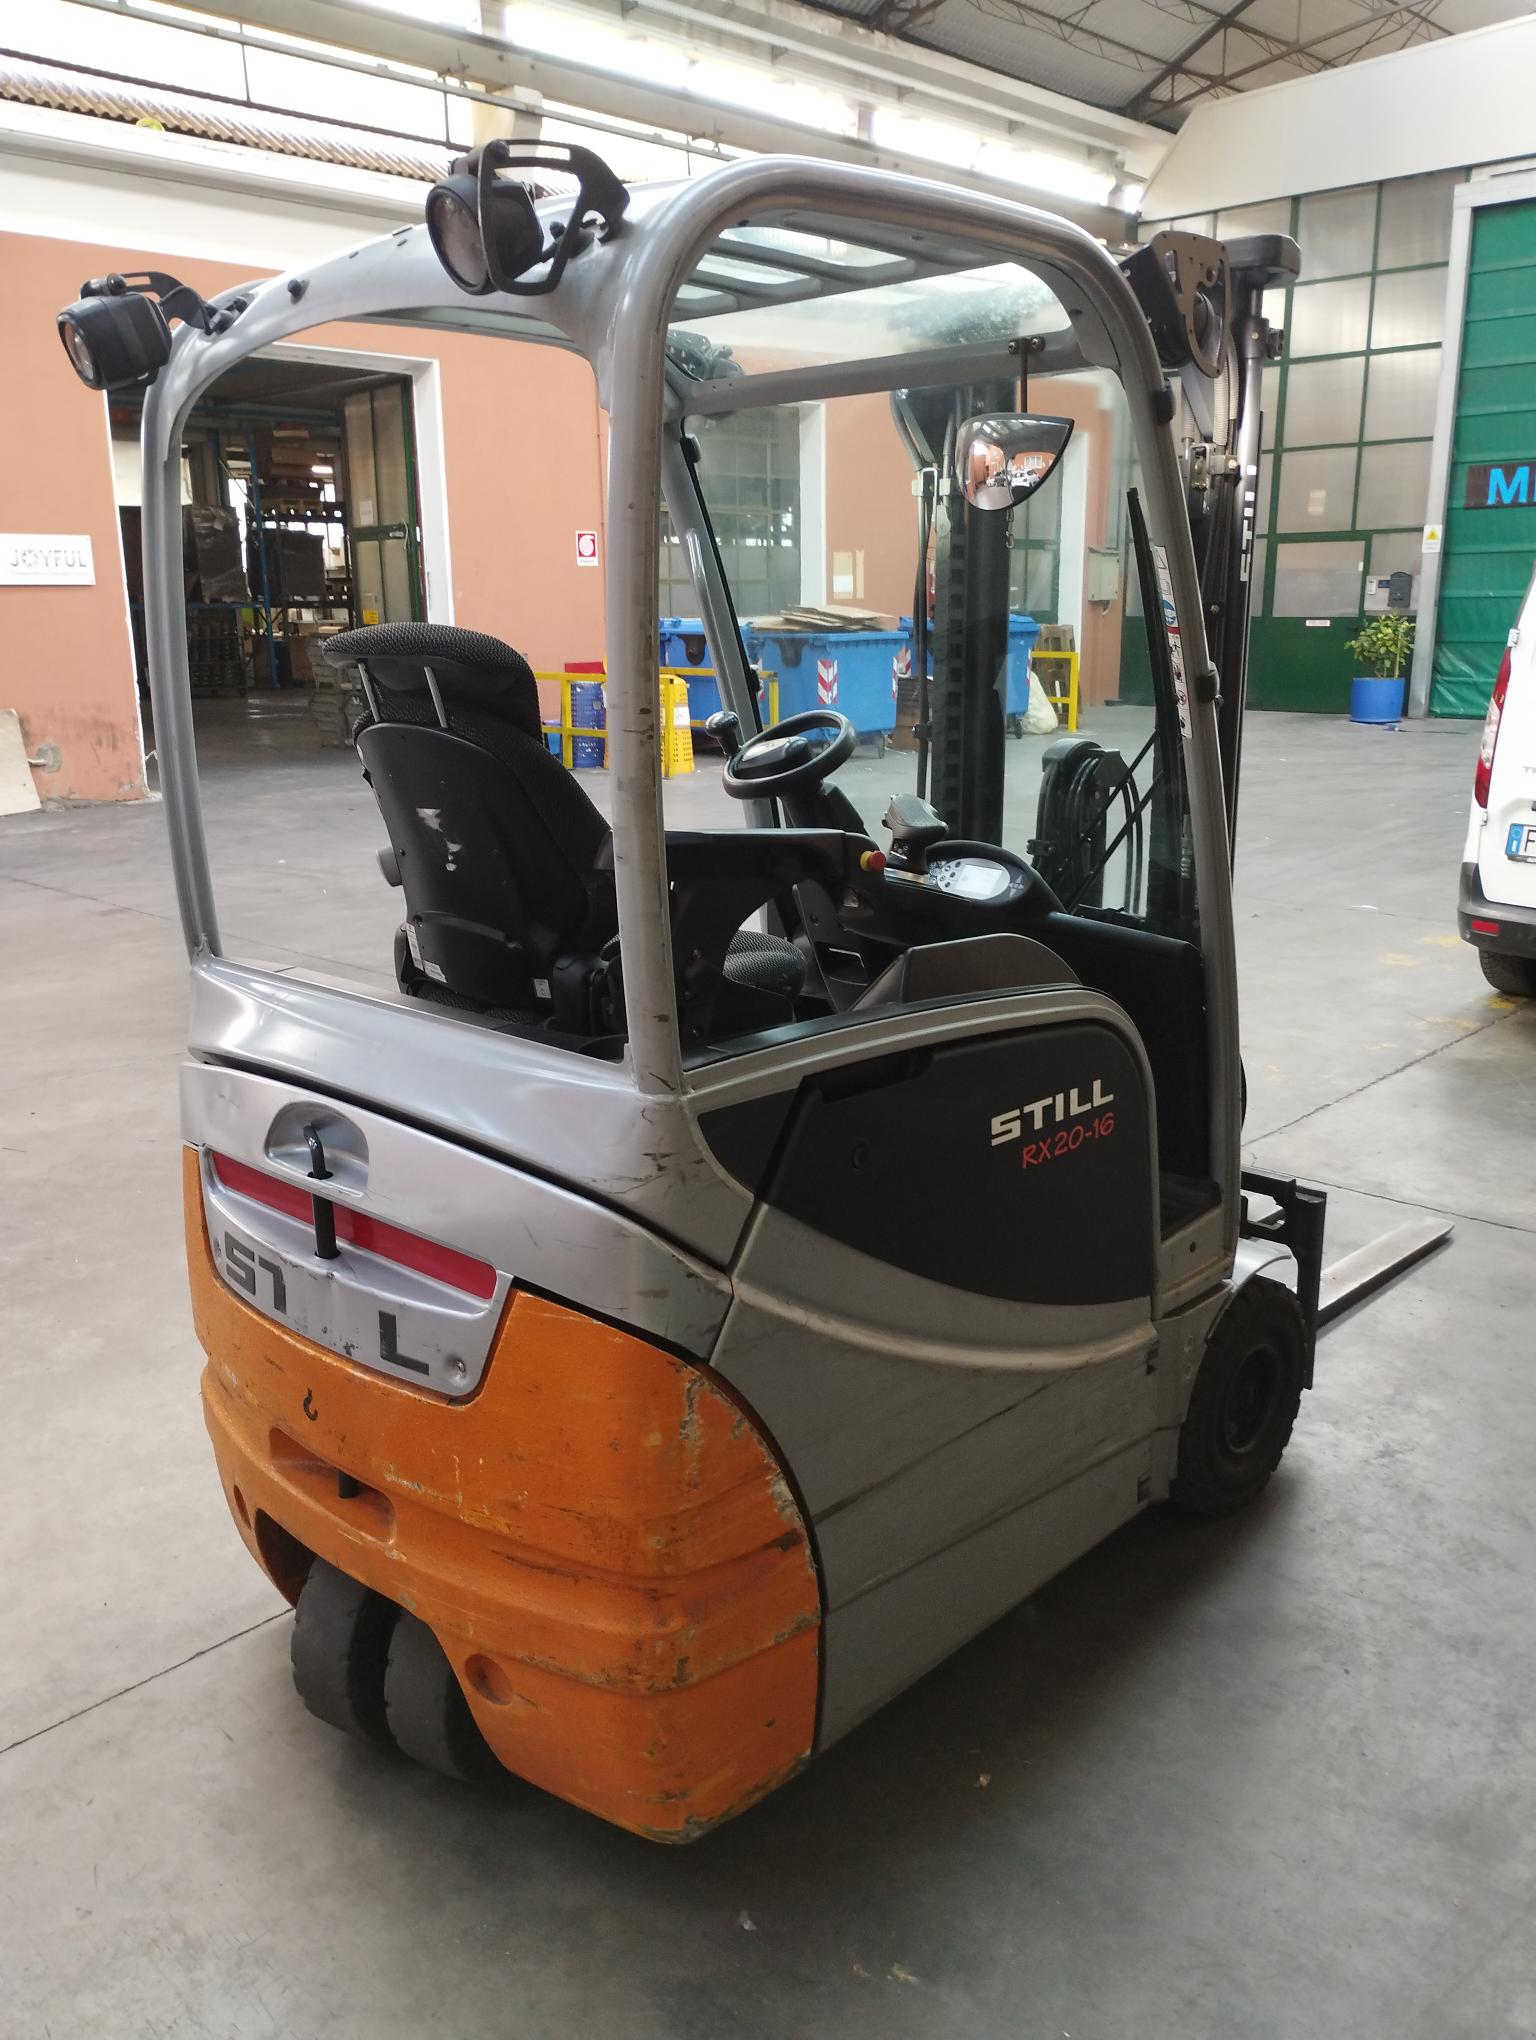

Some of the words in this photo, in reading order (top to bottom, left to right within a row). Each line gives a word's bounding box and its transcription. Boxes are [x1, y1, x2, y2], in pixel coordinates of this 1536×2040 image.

[10, 548, 88, 568] JOYFUL
[991, 1079, 1114, 1147] STILL
[224, 1230, 430, 1376] STL
